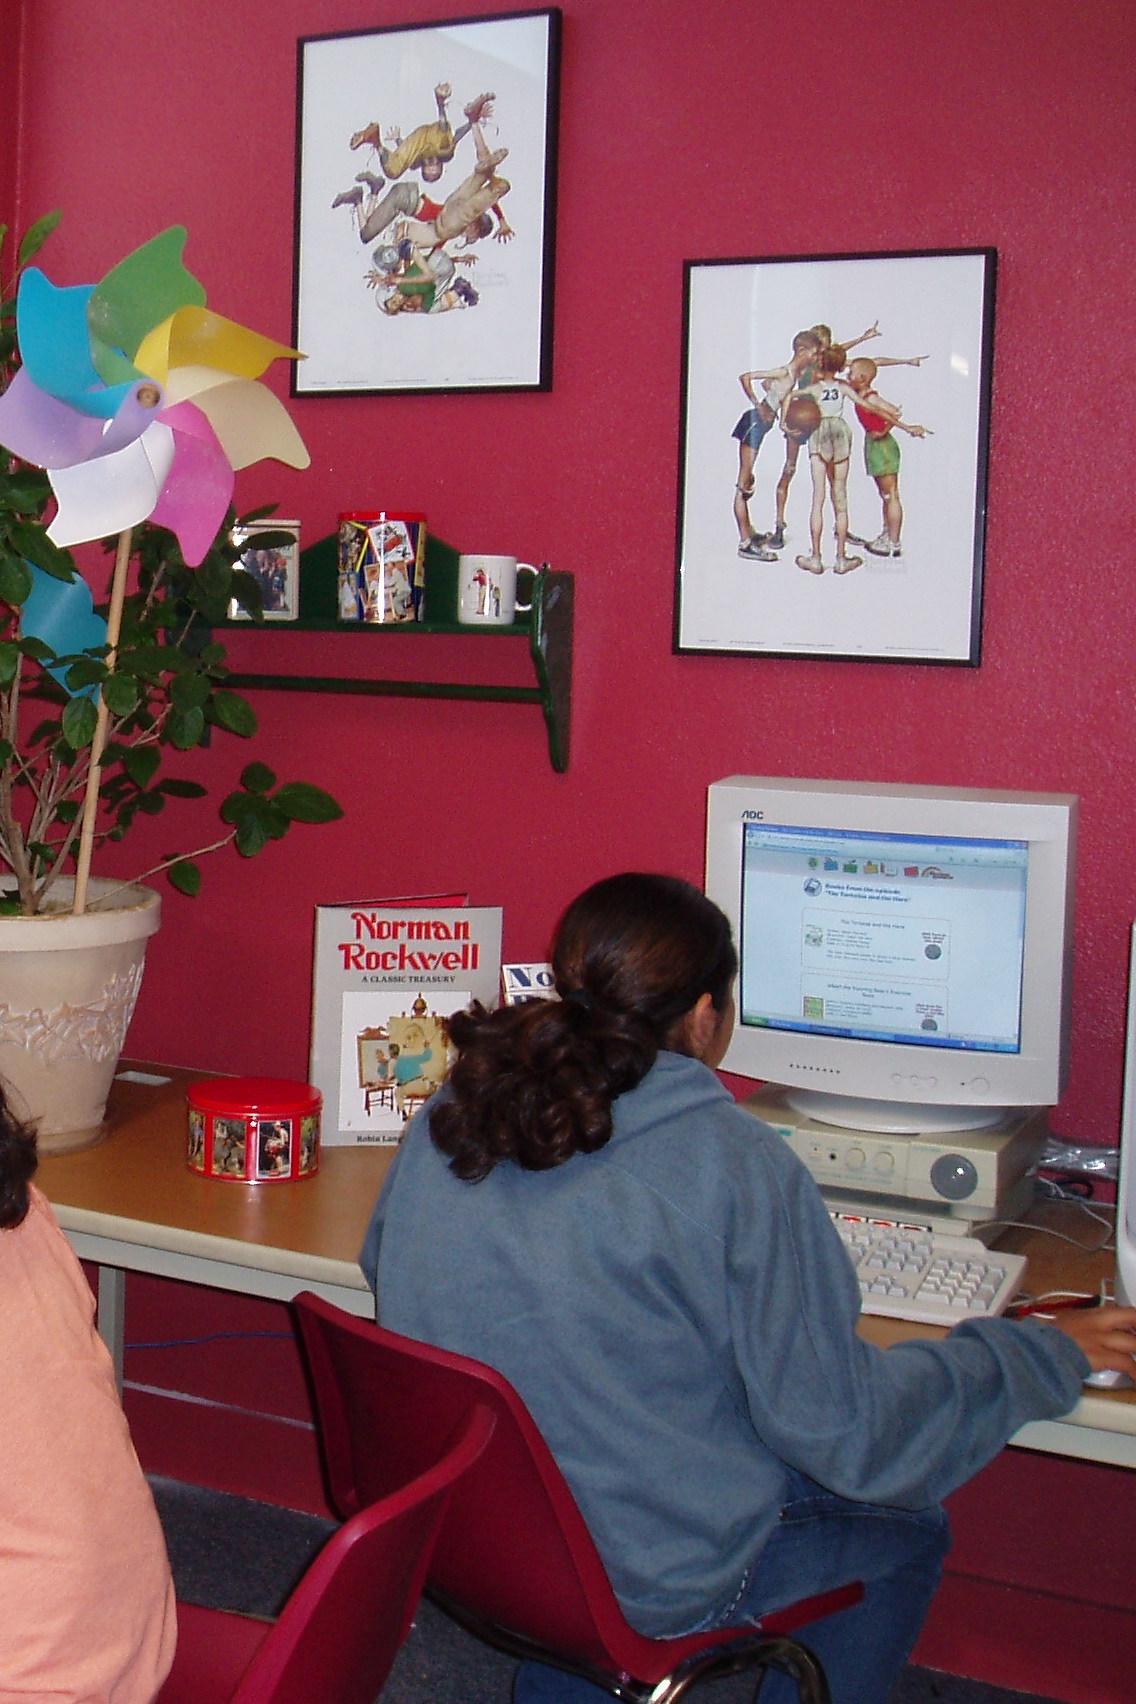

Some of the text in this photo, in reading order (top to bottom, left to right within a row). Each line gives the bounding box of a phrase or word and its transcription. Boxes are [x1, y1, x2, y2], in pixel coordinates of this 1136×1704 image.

[821, 388, 840, 401] 23
[741, 810, 764, 820] AOC
[350, 911, 470, 941] Norman
[337, 943, 480, 971] Rockwell
[370, 975, 406, 983] CLASSIC
[408, 975, 456, 984] TREASURY
[506, 966, 554, 989] No
[382, 1135, 403, 1144] Lang
